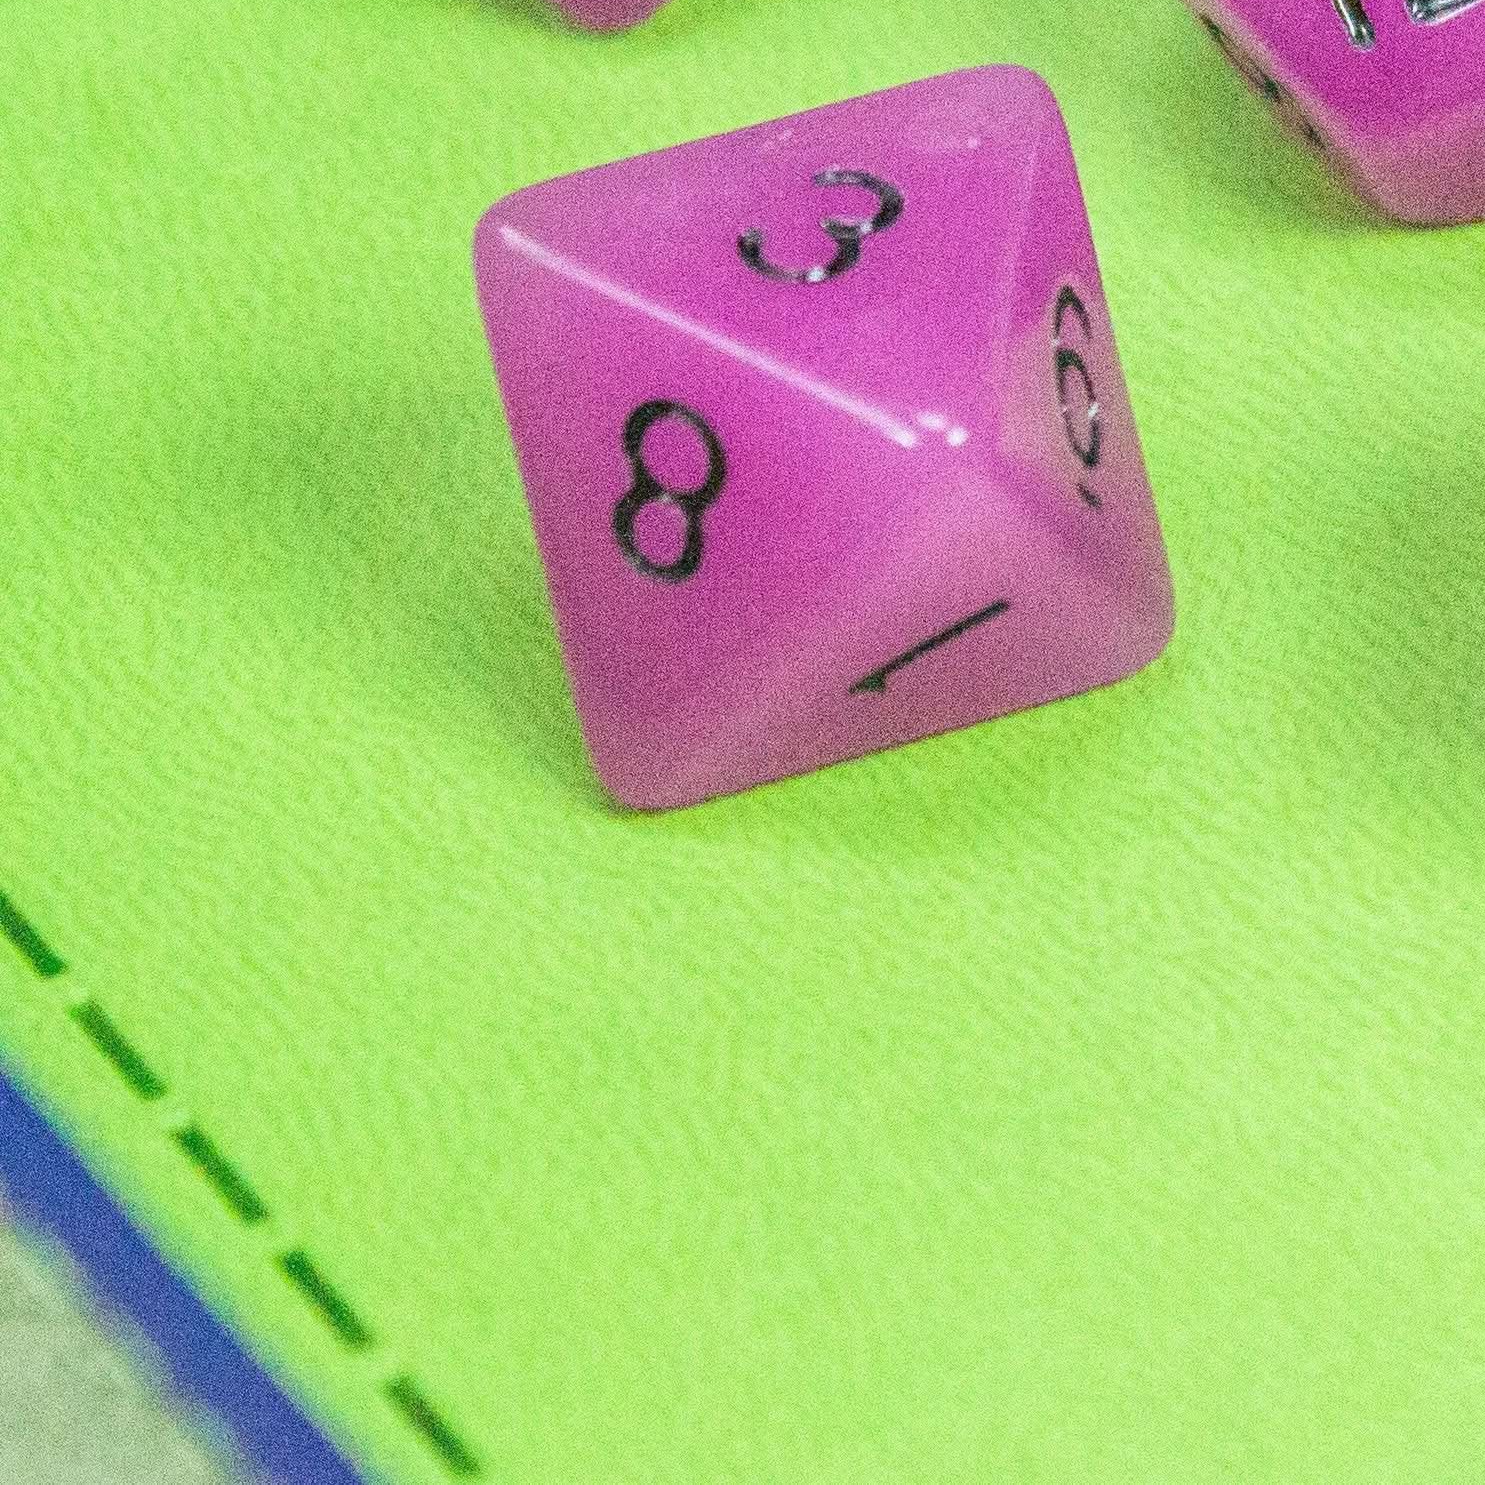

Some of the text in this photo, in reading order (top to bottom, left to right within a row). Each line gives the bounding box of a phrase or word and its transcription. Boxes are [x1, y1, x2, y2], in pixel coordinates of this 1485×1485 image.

[737, 168, 905, 284] 3
[610, 398, 728, 586] 8
[849, 598, 1011, 694] 1
